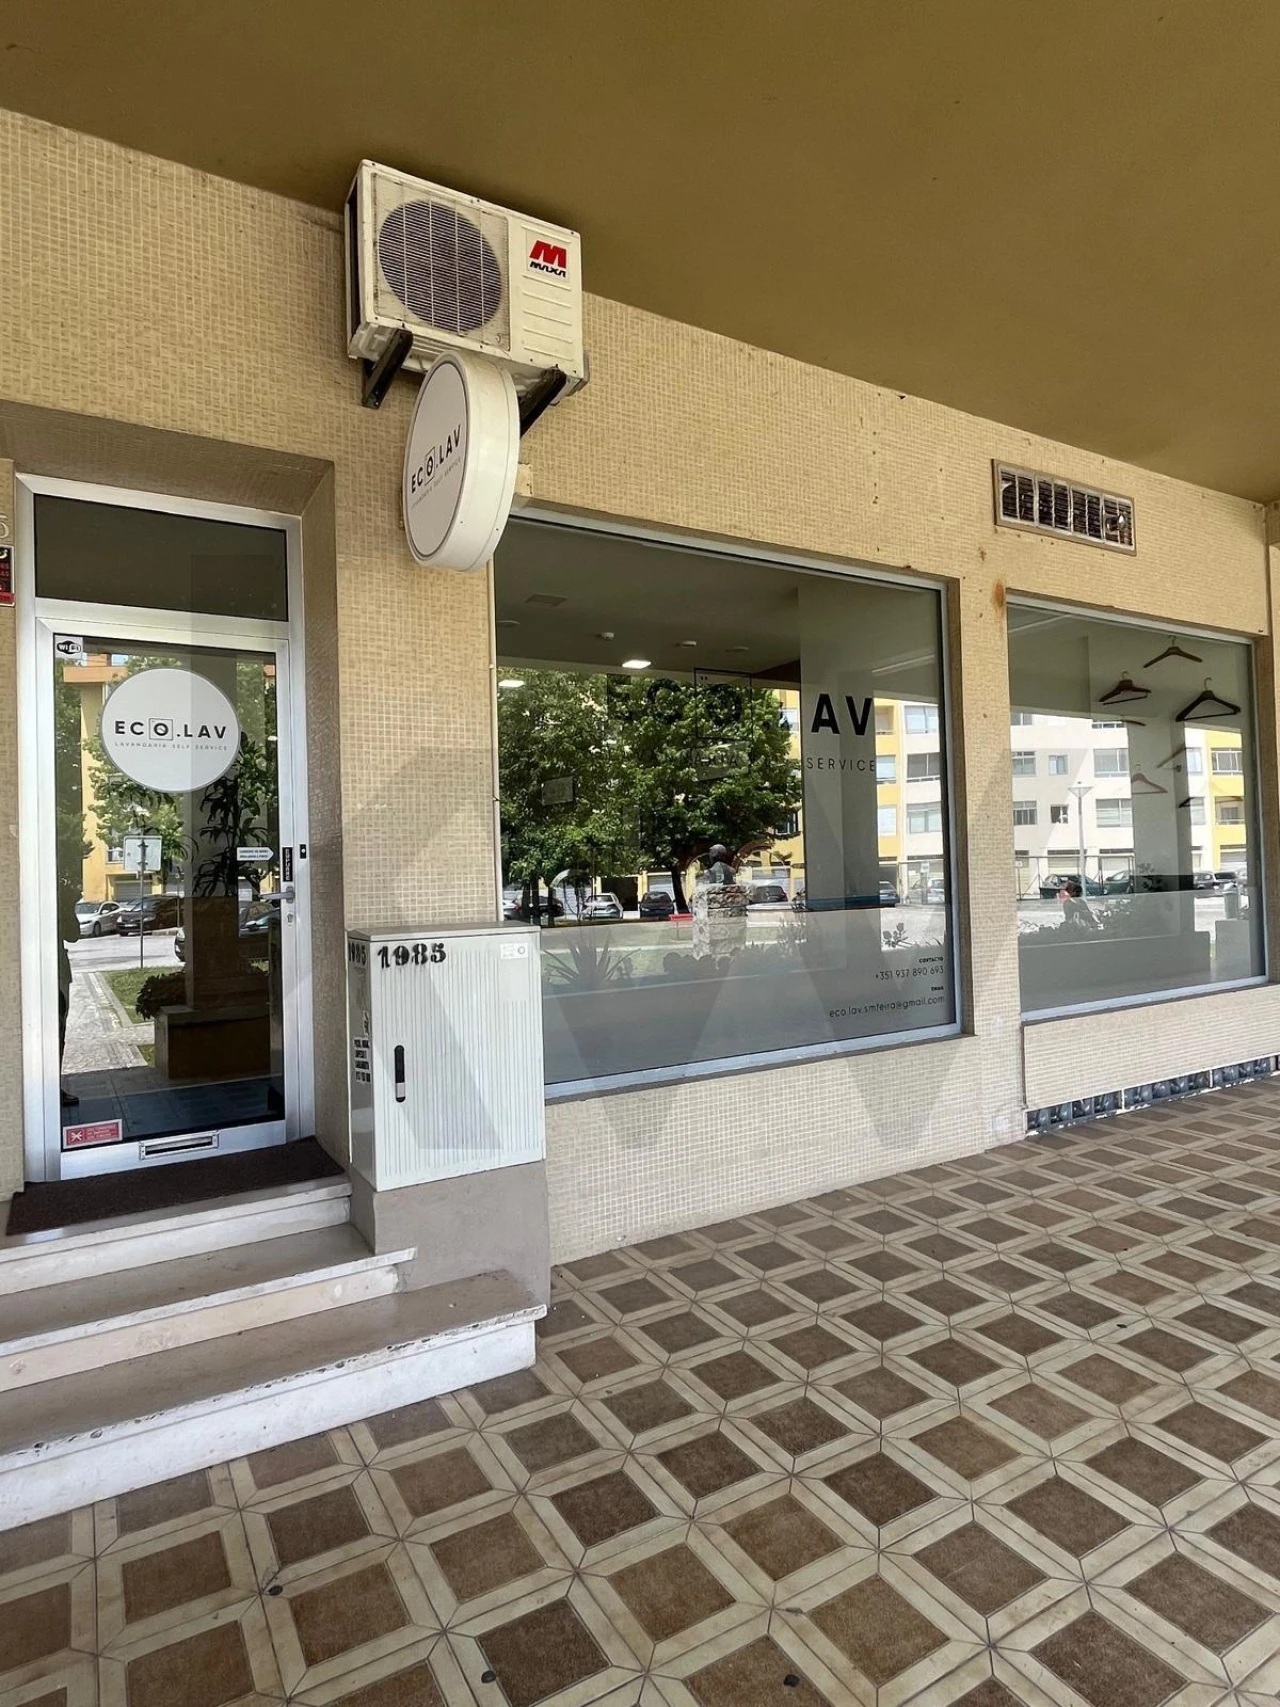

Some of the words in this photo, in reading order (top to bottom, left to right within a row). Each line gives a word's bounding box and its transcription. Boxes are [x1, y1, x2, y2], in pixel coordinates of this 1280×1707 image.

[115, 719, 227, 740] ECO.LAV
[806, 756, 876, 772] SERVICE
[377, 942, 447, 969] 1985
